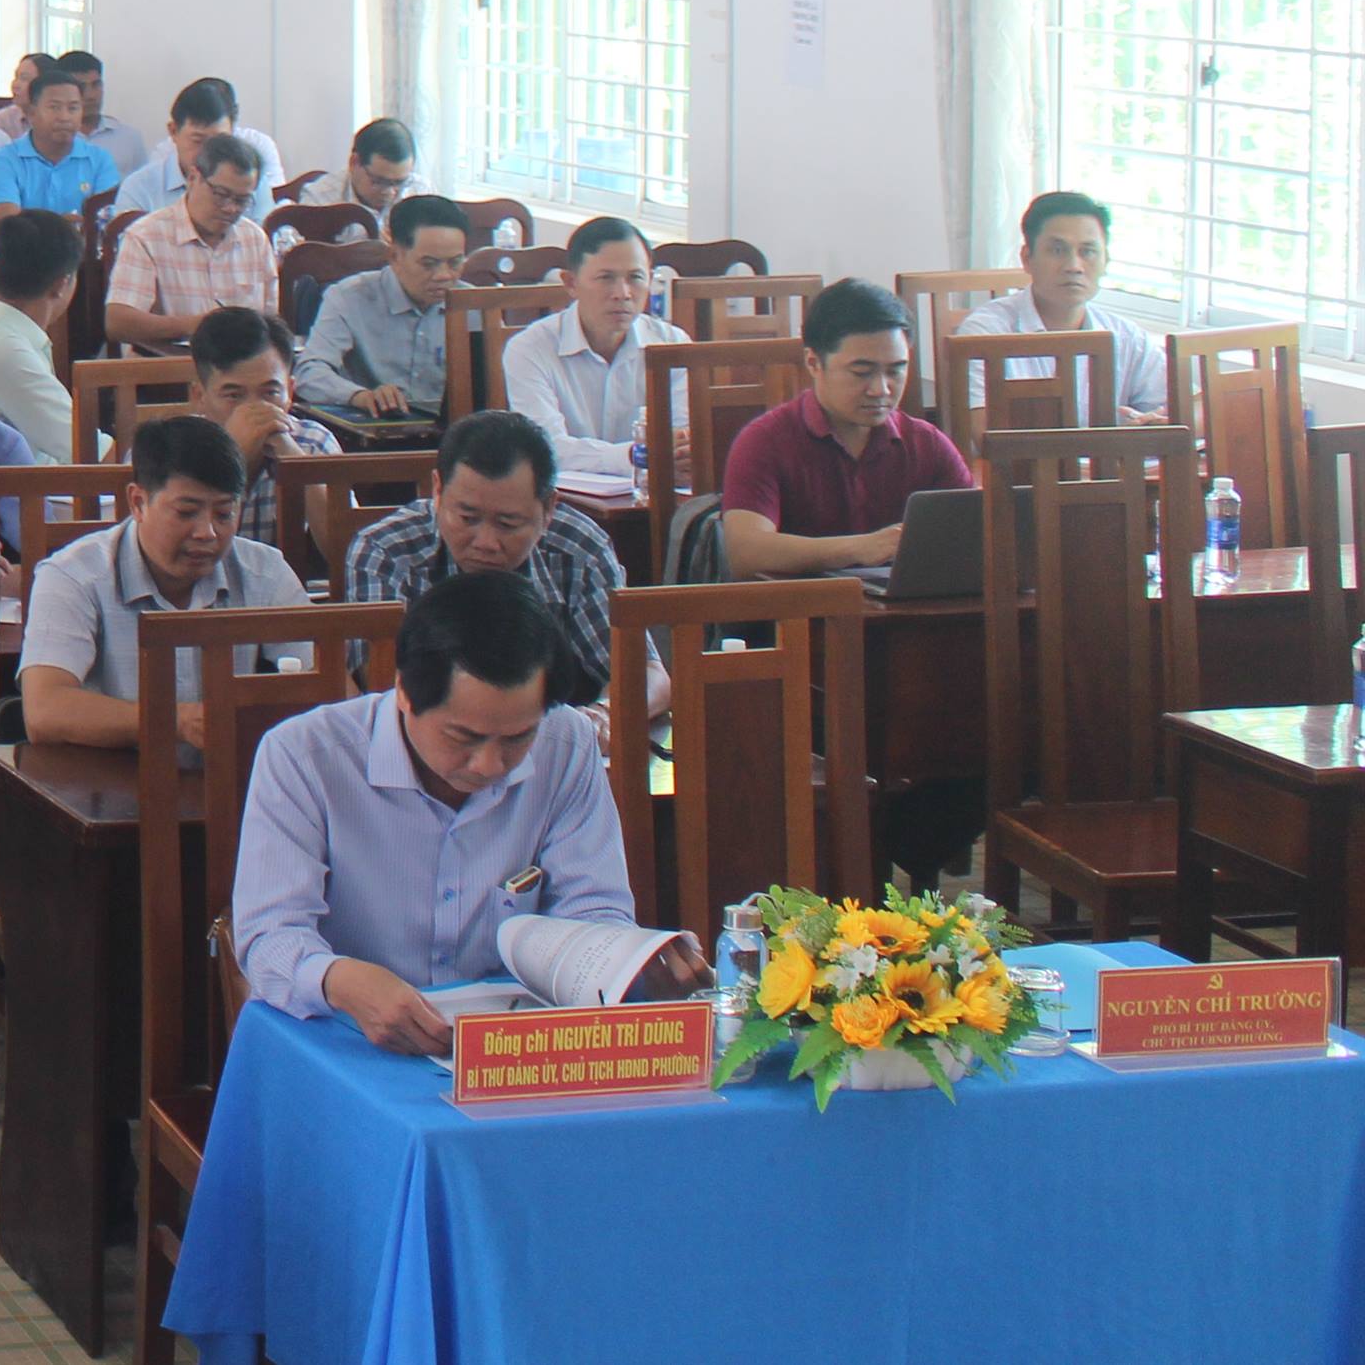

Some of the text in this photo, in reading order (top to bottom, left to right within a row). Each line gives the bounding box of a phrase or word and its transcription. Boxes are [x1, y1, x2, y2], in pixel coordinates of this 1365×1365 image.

[1195, 991, 1231, 1015] CHÍ
[1236, 989, 1322, 1012] TRƯỜNG
[484, 1016, 684, 1057] Đồng chí NGUYỄN TRÍ DŨNG
[467, 1064, 479, 1088] BÍ
[482, 1065, 505, 1088] THƯ
[507, 1059, 539, 1086] ĐẢNG
[562, 1055, 585, 1083] CHỦ
[589, 1060, 614, 1085] TỊCH
[617, 1058, 649, 1079] HĐND
[652, 1051, 700, 1077] PHƯỜNG
